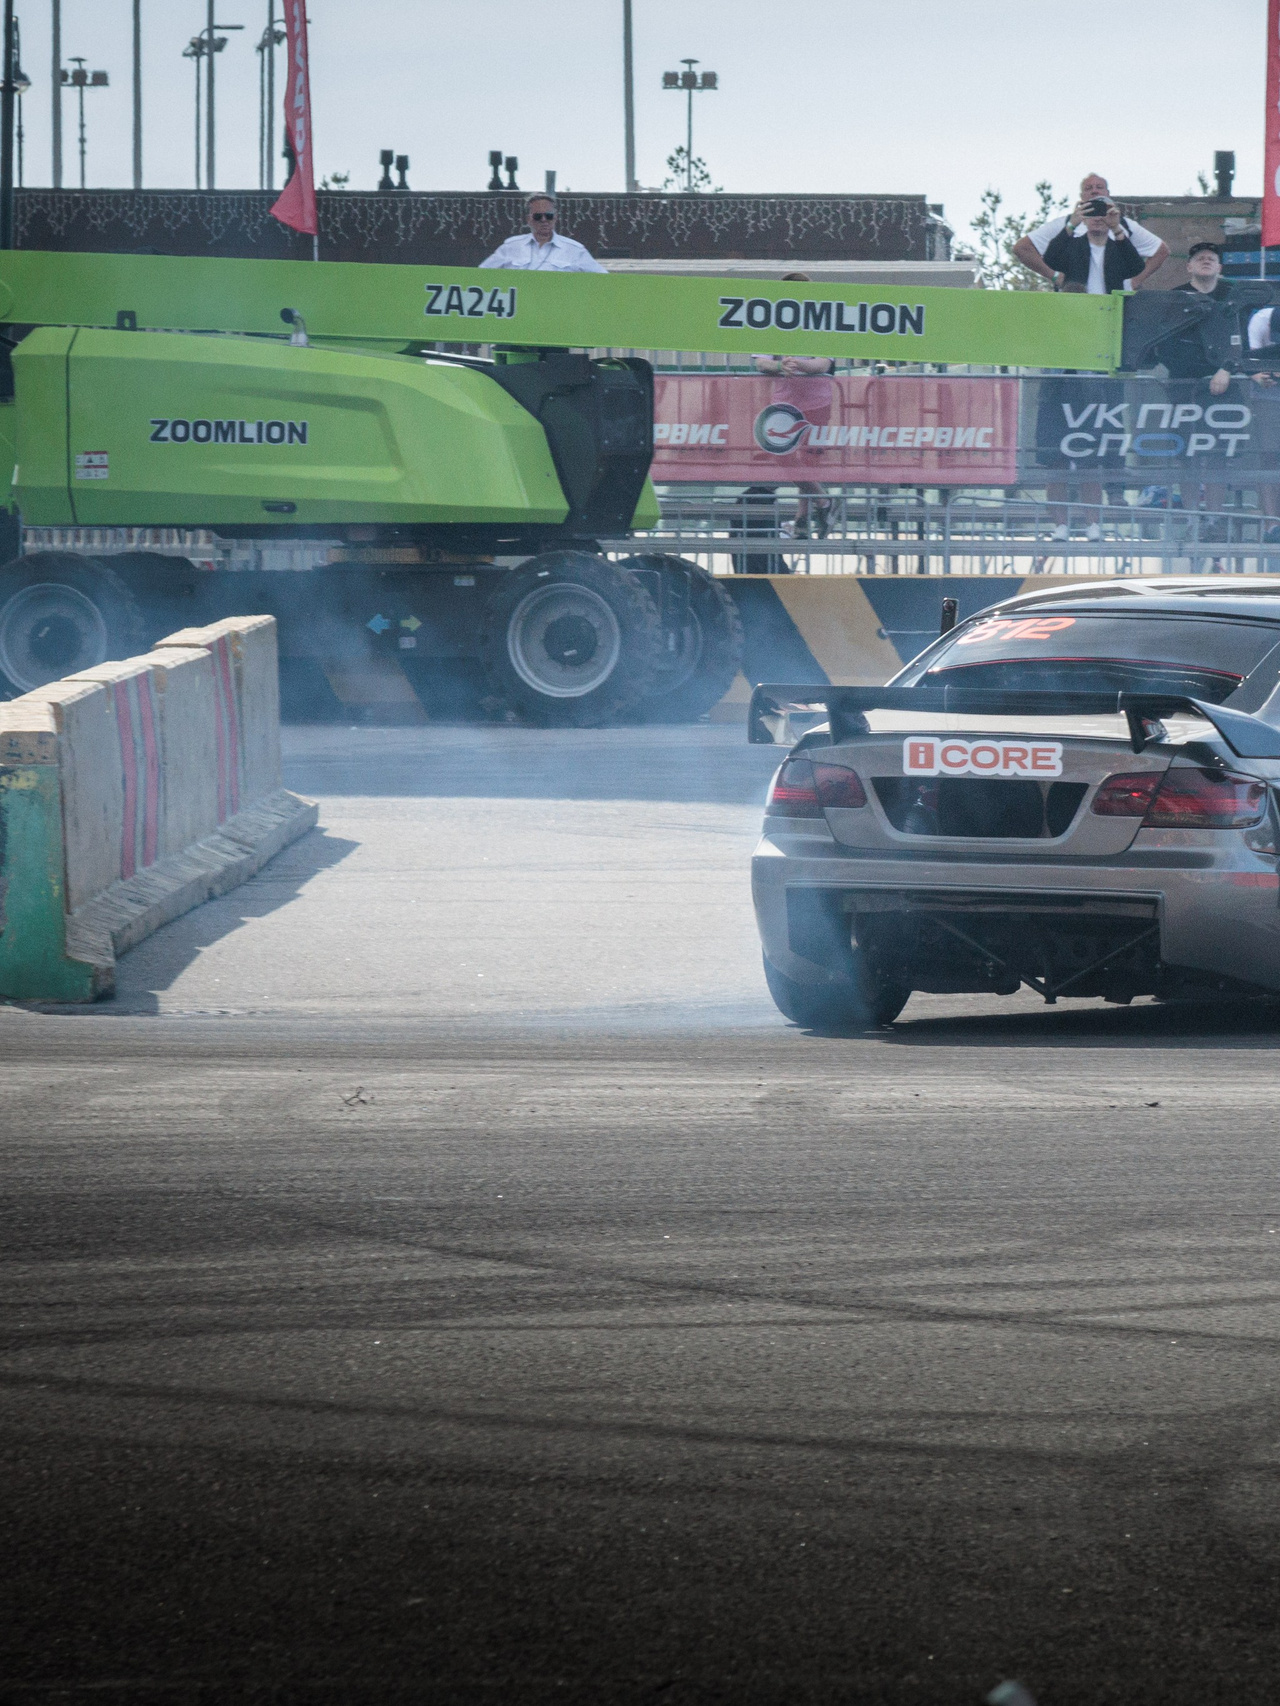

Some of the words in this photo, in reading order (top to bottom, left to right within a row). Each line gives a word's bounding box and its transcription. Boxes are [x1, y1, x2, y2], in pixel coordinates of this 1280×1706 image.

[425, 284, 517, 318] ZA24J
[719, 297, 924, 336] ZOOMLION
[1062, 403, 1131, 429] VK
[1136, 403, 1252, 429] ПРО
[150, 419, 308, 445] ZOOMLION
[653, 423, 729, 445] РВИС
[808, 424, 994, 449] ШИНСЕРВИС
[1060, 432, 1251, 458] СПОРТ
